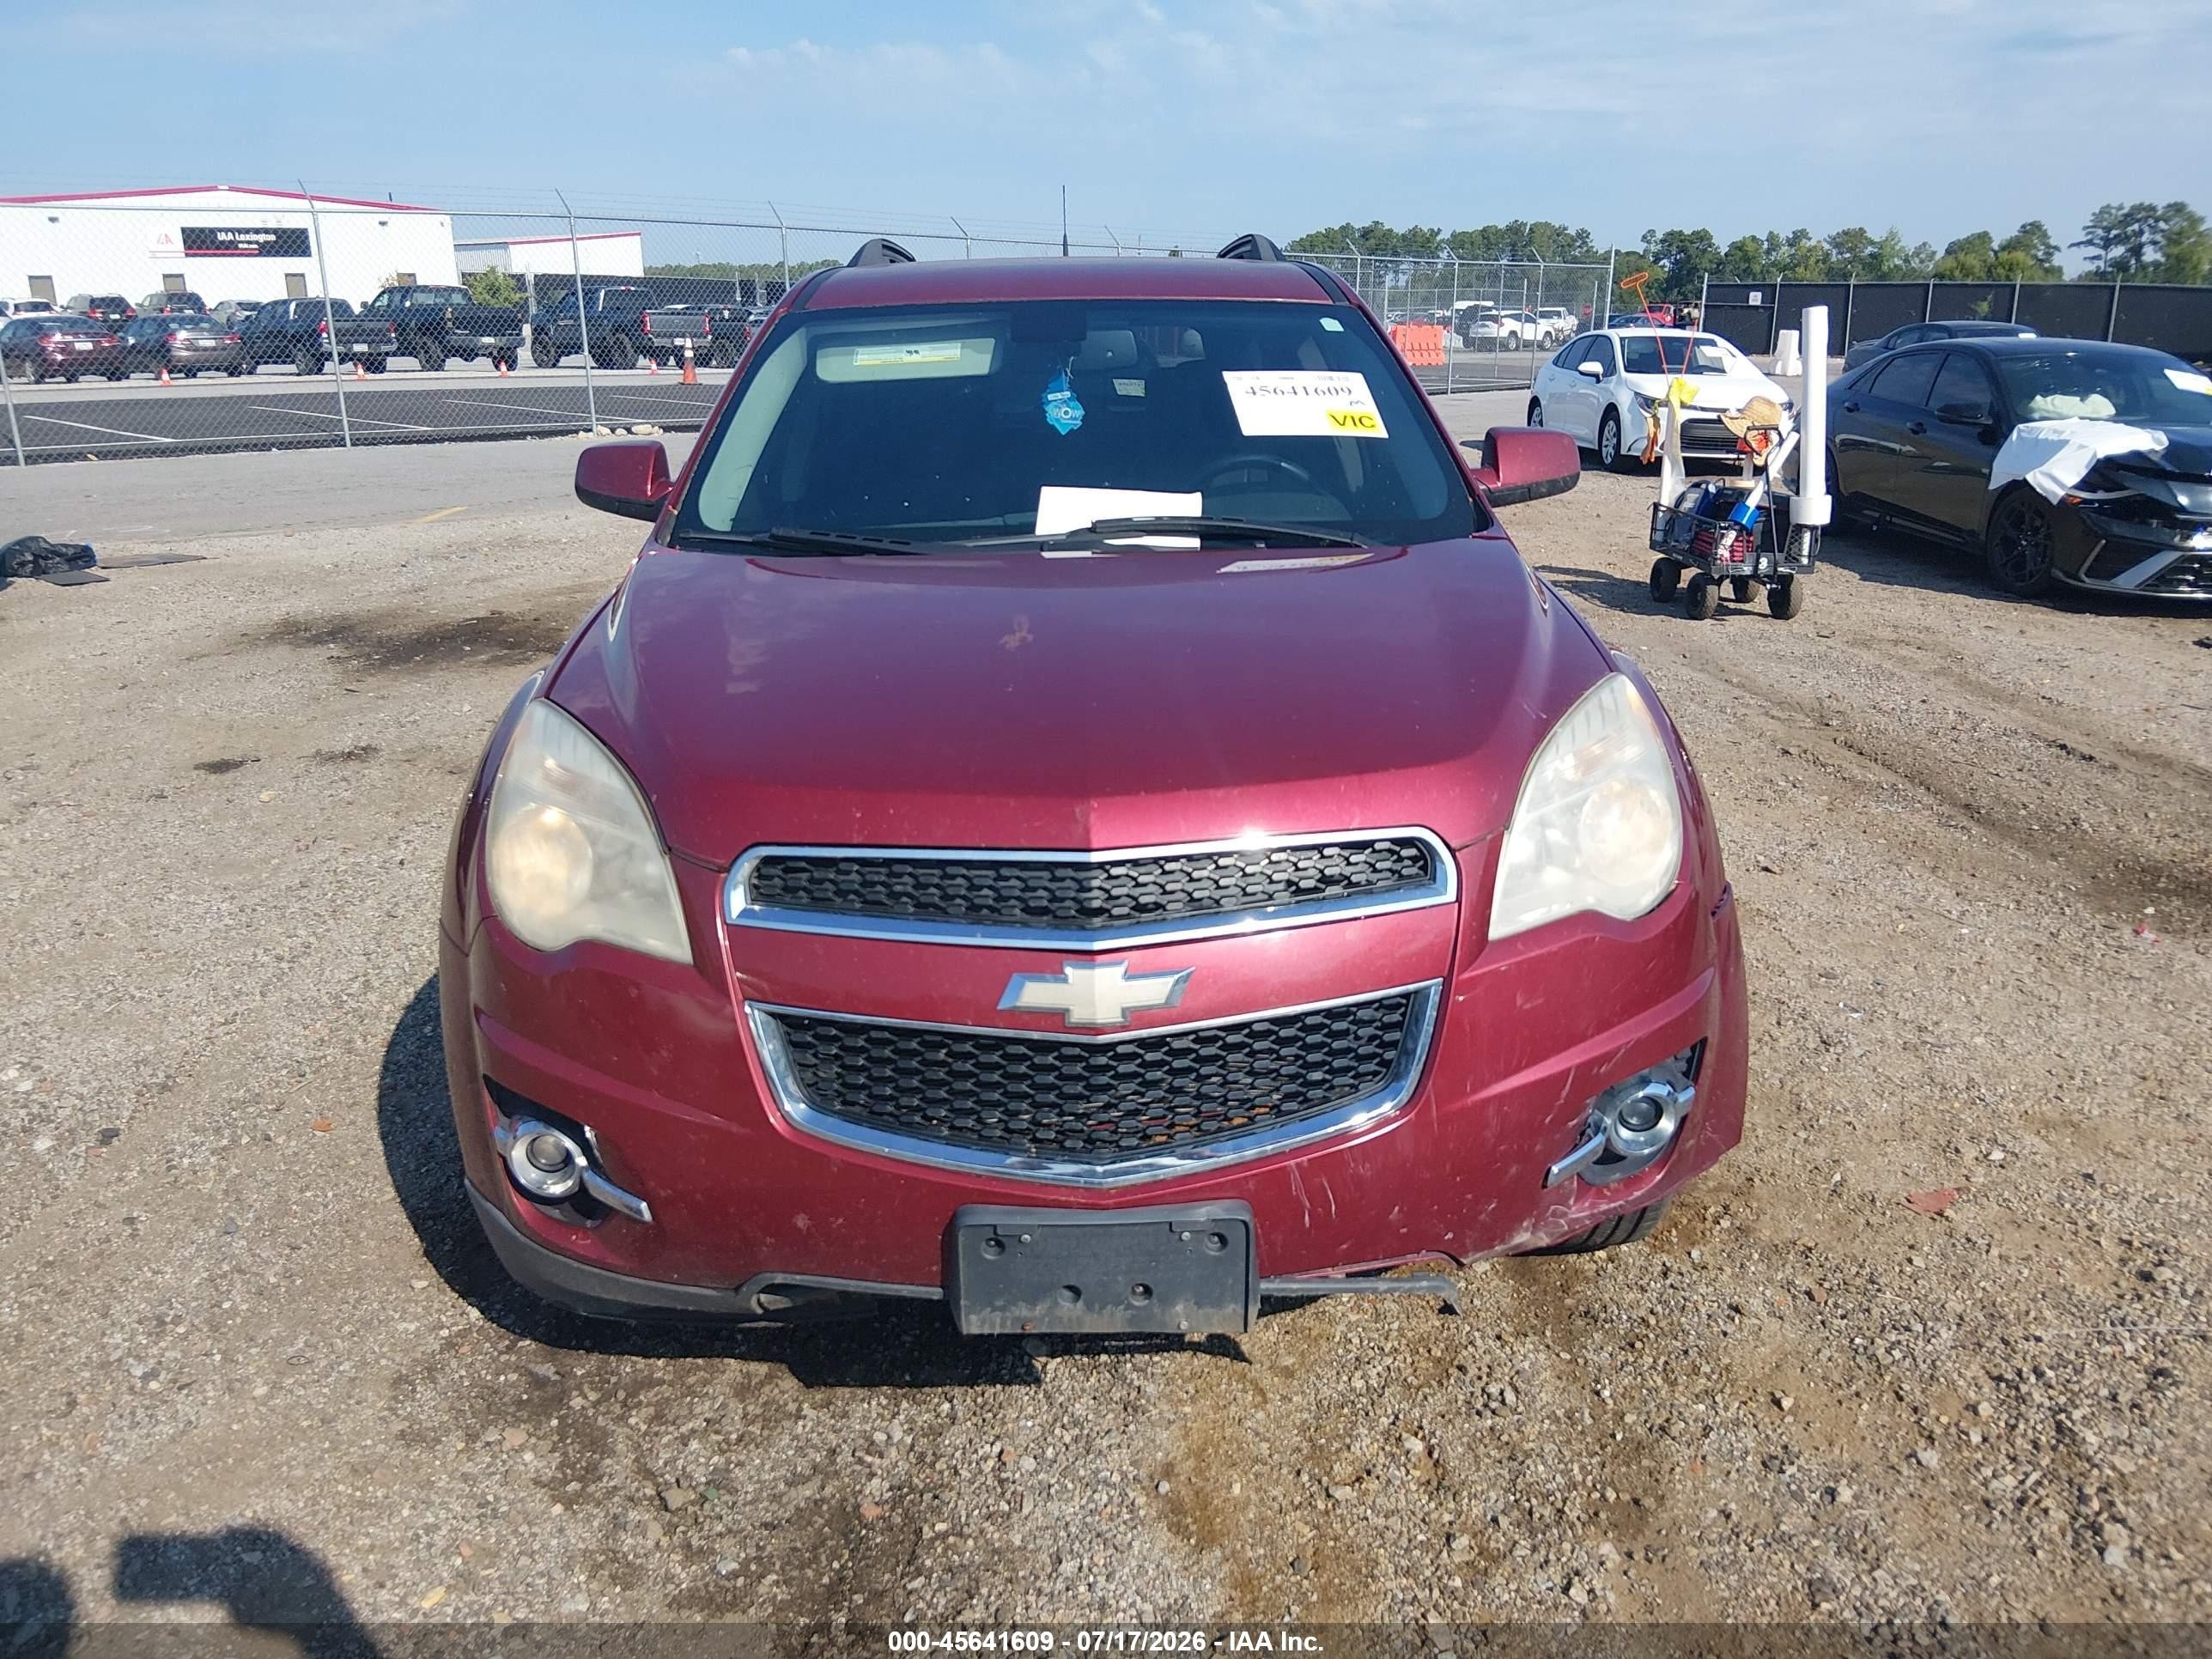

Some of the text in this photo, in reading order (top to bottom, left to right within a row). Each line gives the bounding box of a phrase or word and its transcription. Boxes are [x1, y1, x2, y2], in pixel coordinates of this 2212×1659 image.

[234, 232, 276, 242] Lexington
[1245, 386, 1352, 398] 45641609
[1328, 414, 1376, 428] VIC
